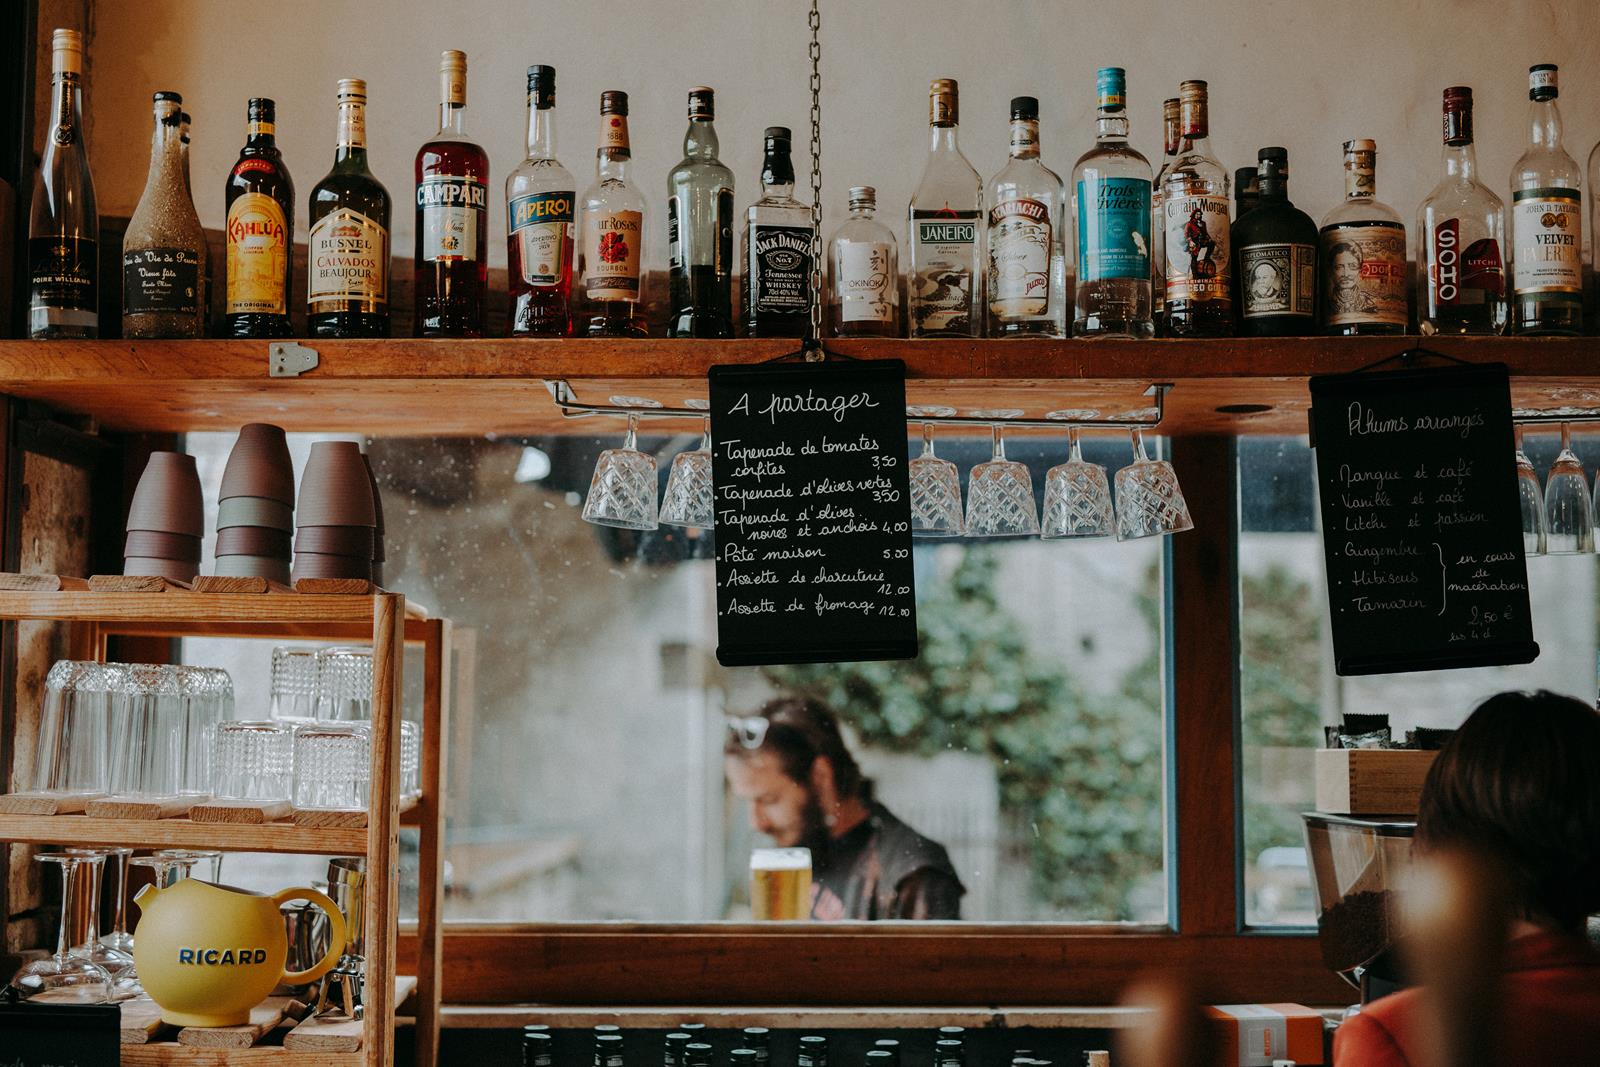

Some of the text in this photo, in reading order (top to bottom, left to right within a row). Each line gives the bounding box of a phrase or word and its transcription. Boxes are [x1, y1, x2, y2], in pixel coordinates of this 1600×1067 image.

[417, 184, 486, 206] CAMPARI
[1100, 185, 1136, 197] Trois
[516, 199, 571, 224] APEROL
[1098, 200, 1144, 210] ivières
[1200, 198, 1228, 216] Morgan
[228, 218, 284, 246] KAHLÚA
[611, 217, 638, 230] Roses
[922, 226, 974, 241] JANEIRO
[1536, 234, 1574, 246] VELVET
[321, 239, 372, 249] BUSNEL
[756, 236, 779, 254] JACK
[317, 257, 376, 268] CALVADOS
[1438, 229, 1457, 300] SOHO
[320, 268, 372, 279] BEAUJOUR
[764, 269, 802, 278] Tennessee
[846, 280, 886, 288] OKINOK
[728, 389, 880, 424] A partager
[720, 434, 880, 468] Tapenade de tomates
[1414, 464, 1428, 479] et
[1437, 457, 1474, 486] café
[719, 475, 892, 511] Tapenade d'olives vertes
[1411, 490, 1424, 505] et
[719, 504, 855, 534] Tapenade d'olives
[1408, 514, 1421, 528] et
[748, 525, 788, 541] noires
[797, 524, 812, 537] et
[818, 519, 878, 536] anchois
[724, 543, 758, 562] Pâté
[762, 545, 826, 560] maison
[1456, 552, 1516, 565] en cours
[726, 566, 884, 587] Assiette de charcuterie
[1472, 568, 1490, 578] de
[727, 598, 776, 615] Assiette
[785, 598, 806, 612] de
[815, 594, 875, 616] fromage
[179, 949, 266, 966] RICARD
